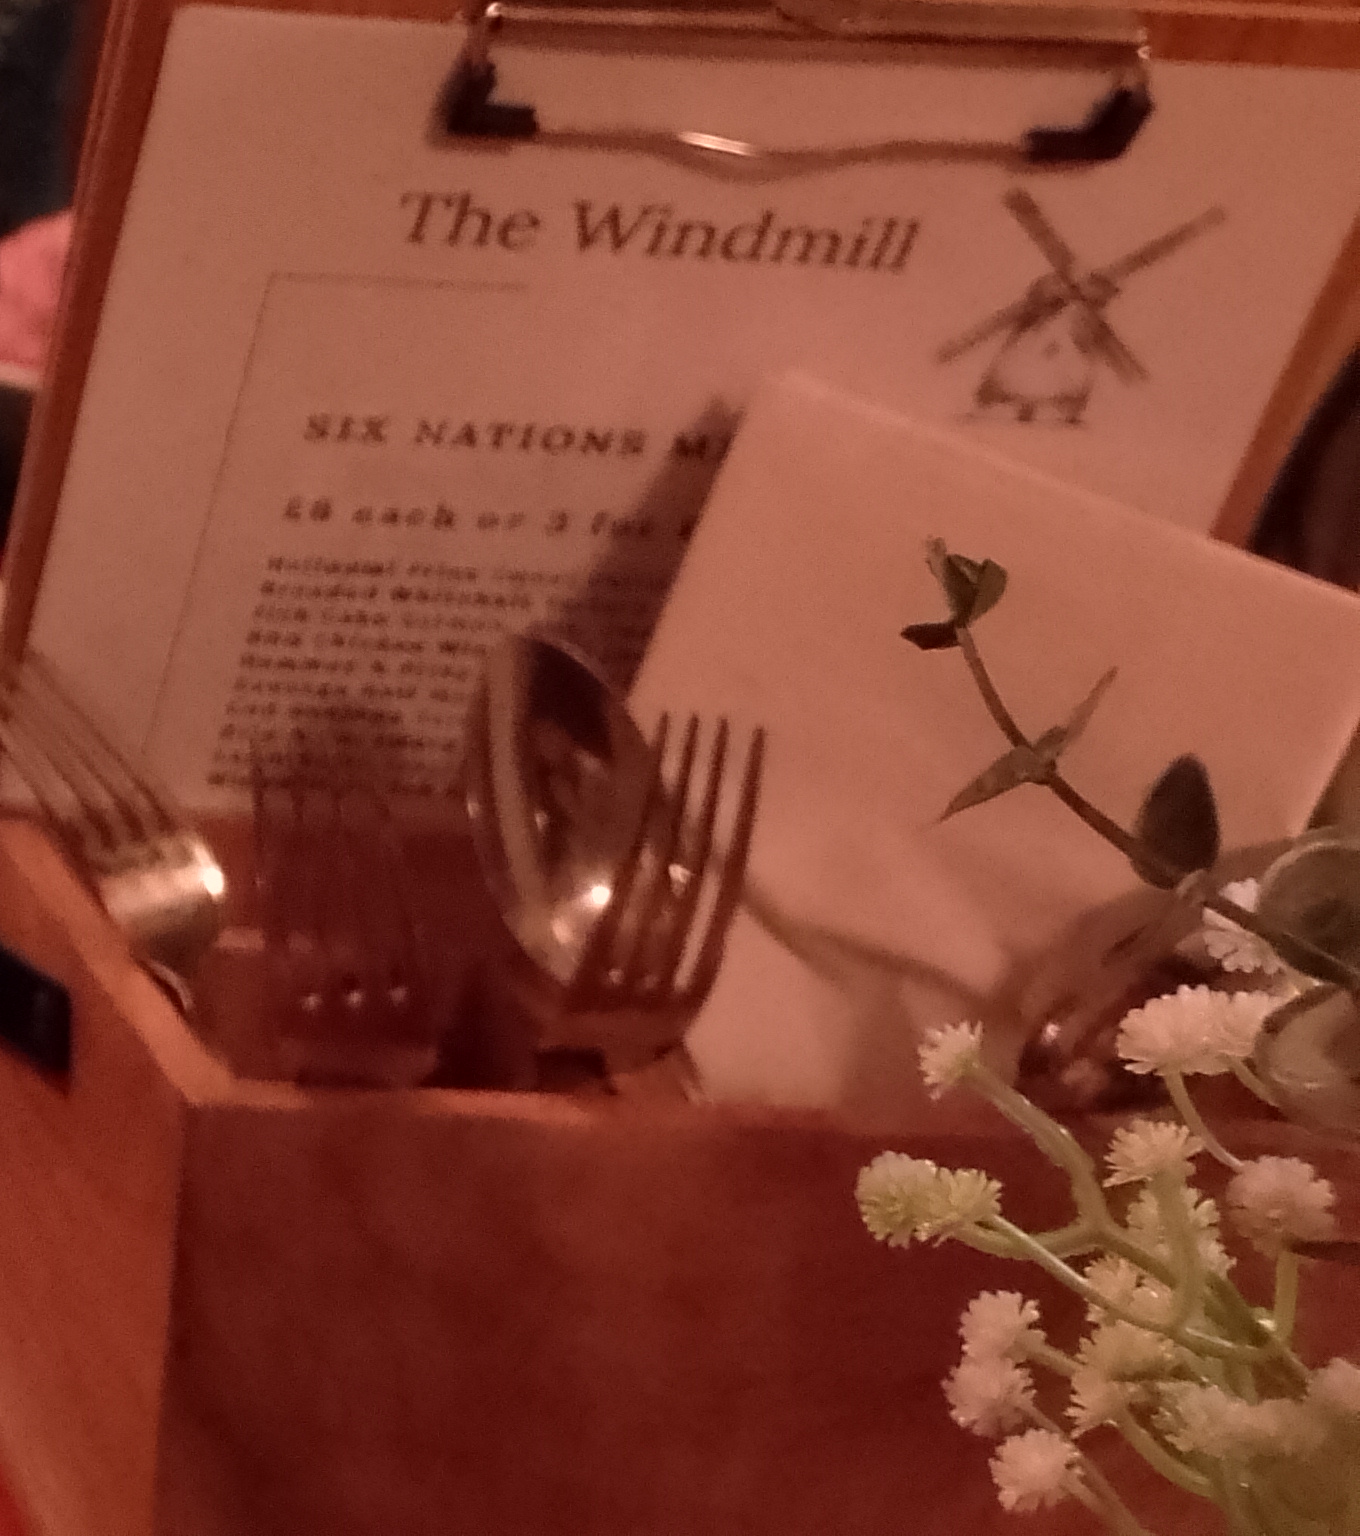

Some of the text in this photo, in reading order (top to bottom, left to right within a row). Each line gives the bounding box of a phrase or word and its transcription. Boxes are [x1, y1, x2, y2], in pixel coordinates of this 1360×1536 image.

[398, 189, 922, 275] The Windmill
[302, 412, 389, 445] SIX
[413, 416, 648, 457] NATIONS
